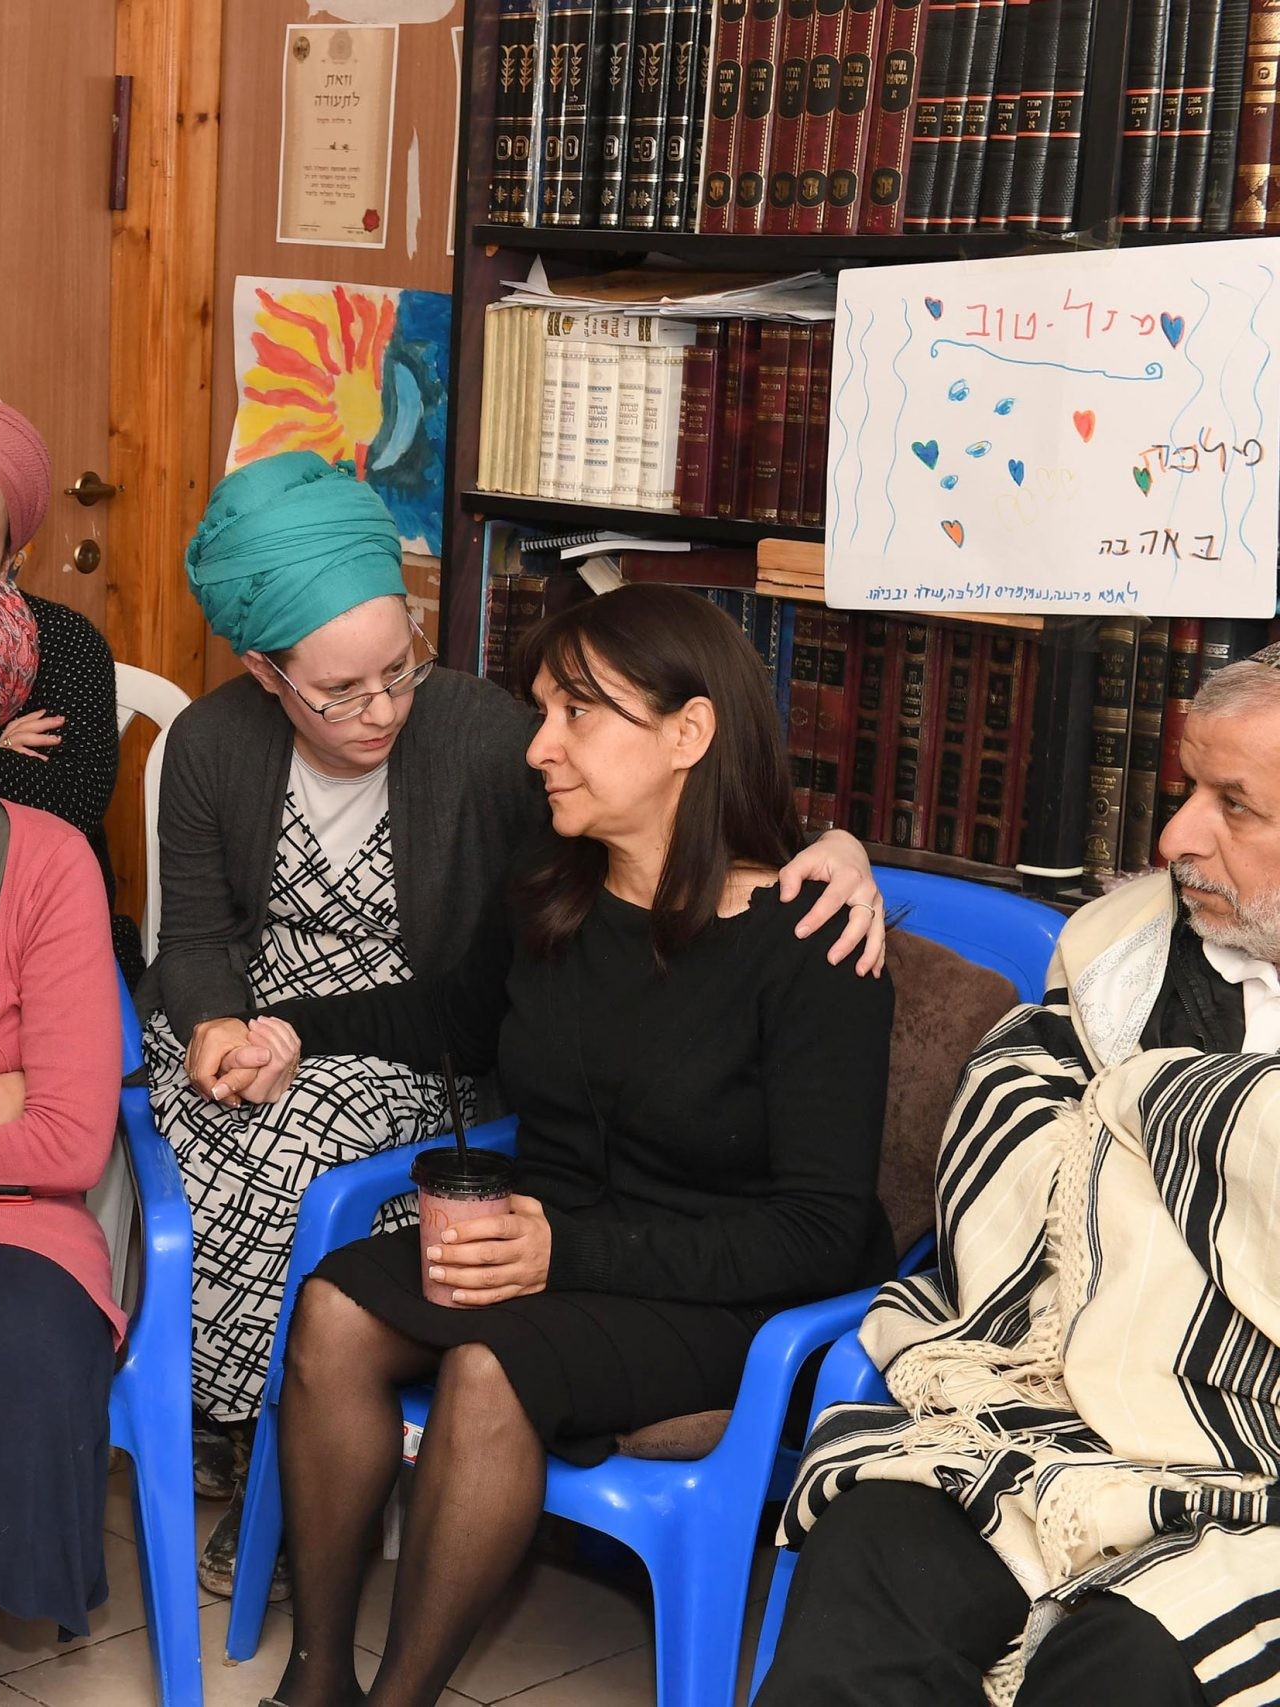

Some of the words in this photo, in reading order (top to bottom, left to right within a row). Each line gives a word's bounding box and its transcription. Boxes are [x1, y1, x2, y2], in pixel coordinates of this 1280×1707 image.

[325, 74, 352, 88] וזאת
[314, 92, 360, 109] לתעודה
[1098, 581, 1138, 603] לאמא
